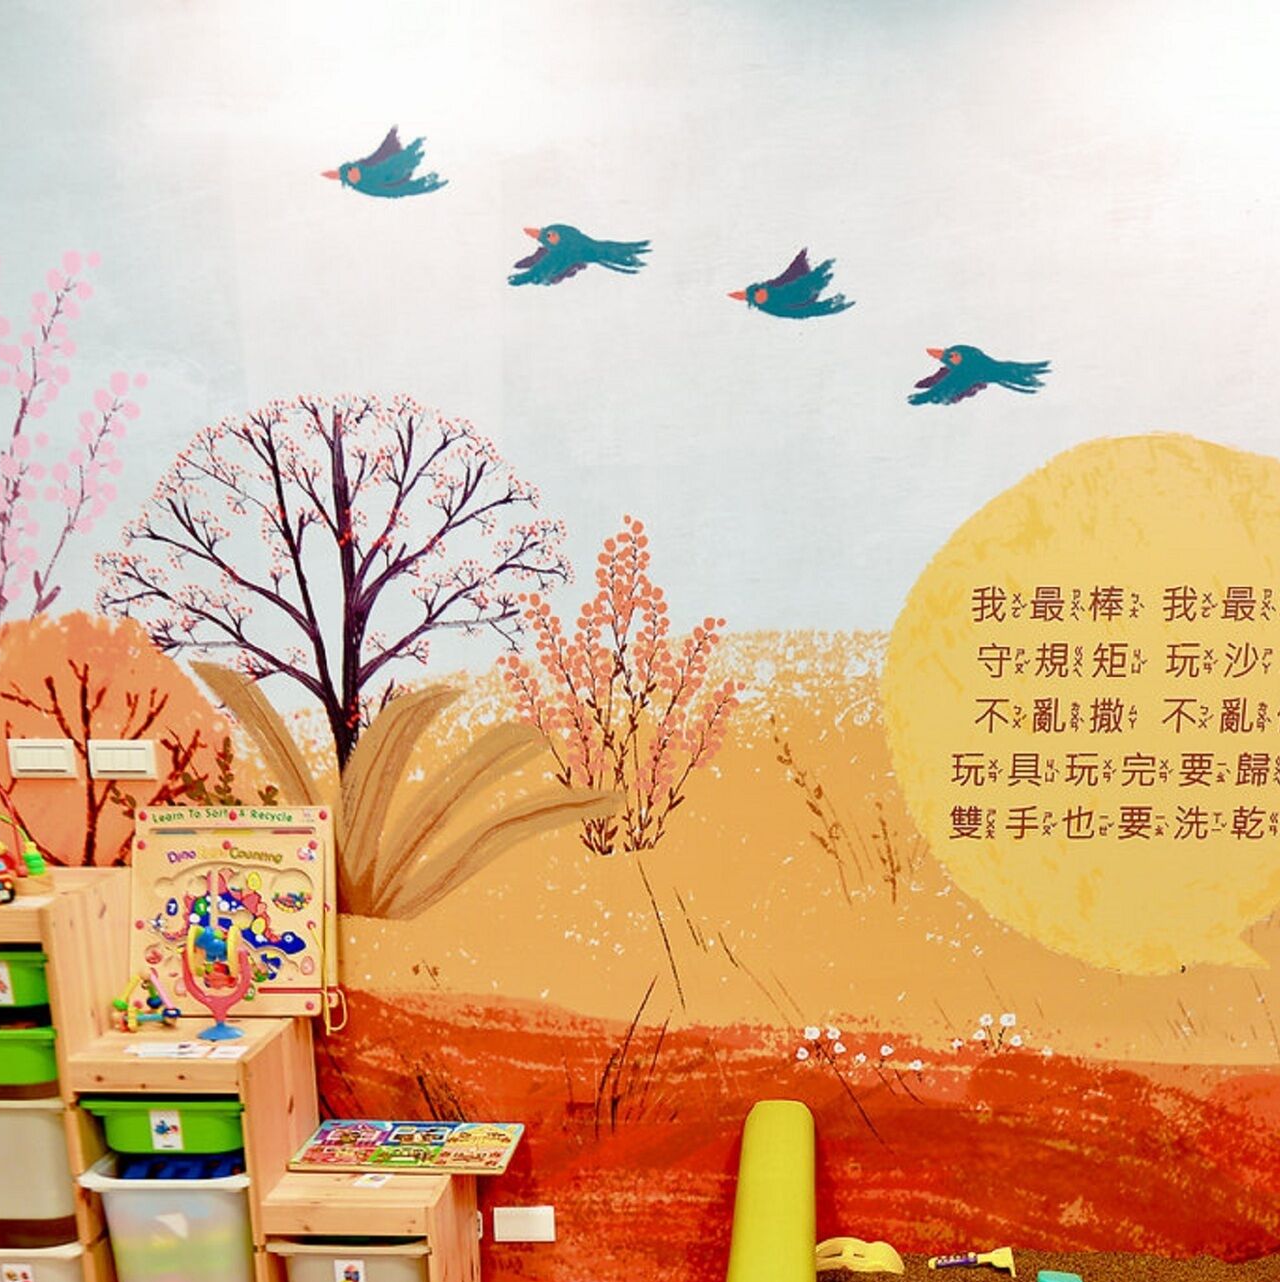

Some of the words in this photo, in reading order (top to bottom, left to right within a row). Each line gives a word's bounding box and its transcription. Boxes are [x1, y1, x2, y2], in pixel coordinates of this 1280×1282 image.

[972, 586, 1124, 622] 我最棒
[977, 642, 1128, 678] 守規矩
[975, 698, 1124, 733] 不亂撒
[152, 810, 185, 823] Learn
[189, 808, 201, 819] To
[205, 808, 228, 819] Sort
[250, 810, 293, 823] Recycle
[167, 850, 197, 864] Dino
[228, 847, 283, 864] Counting
